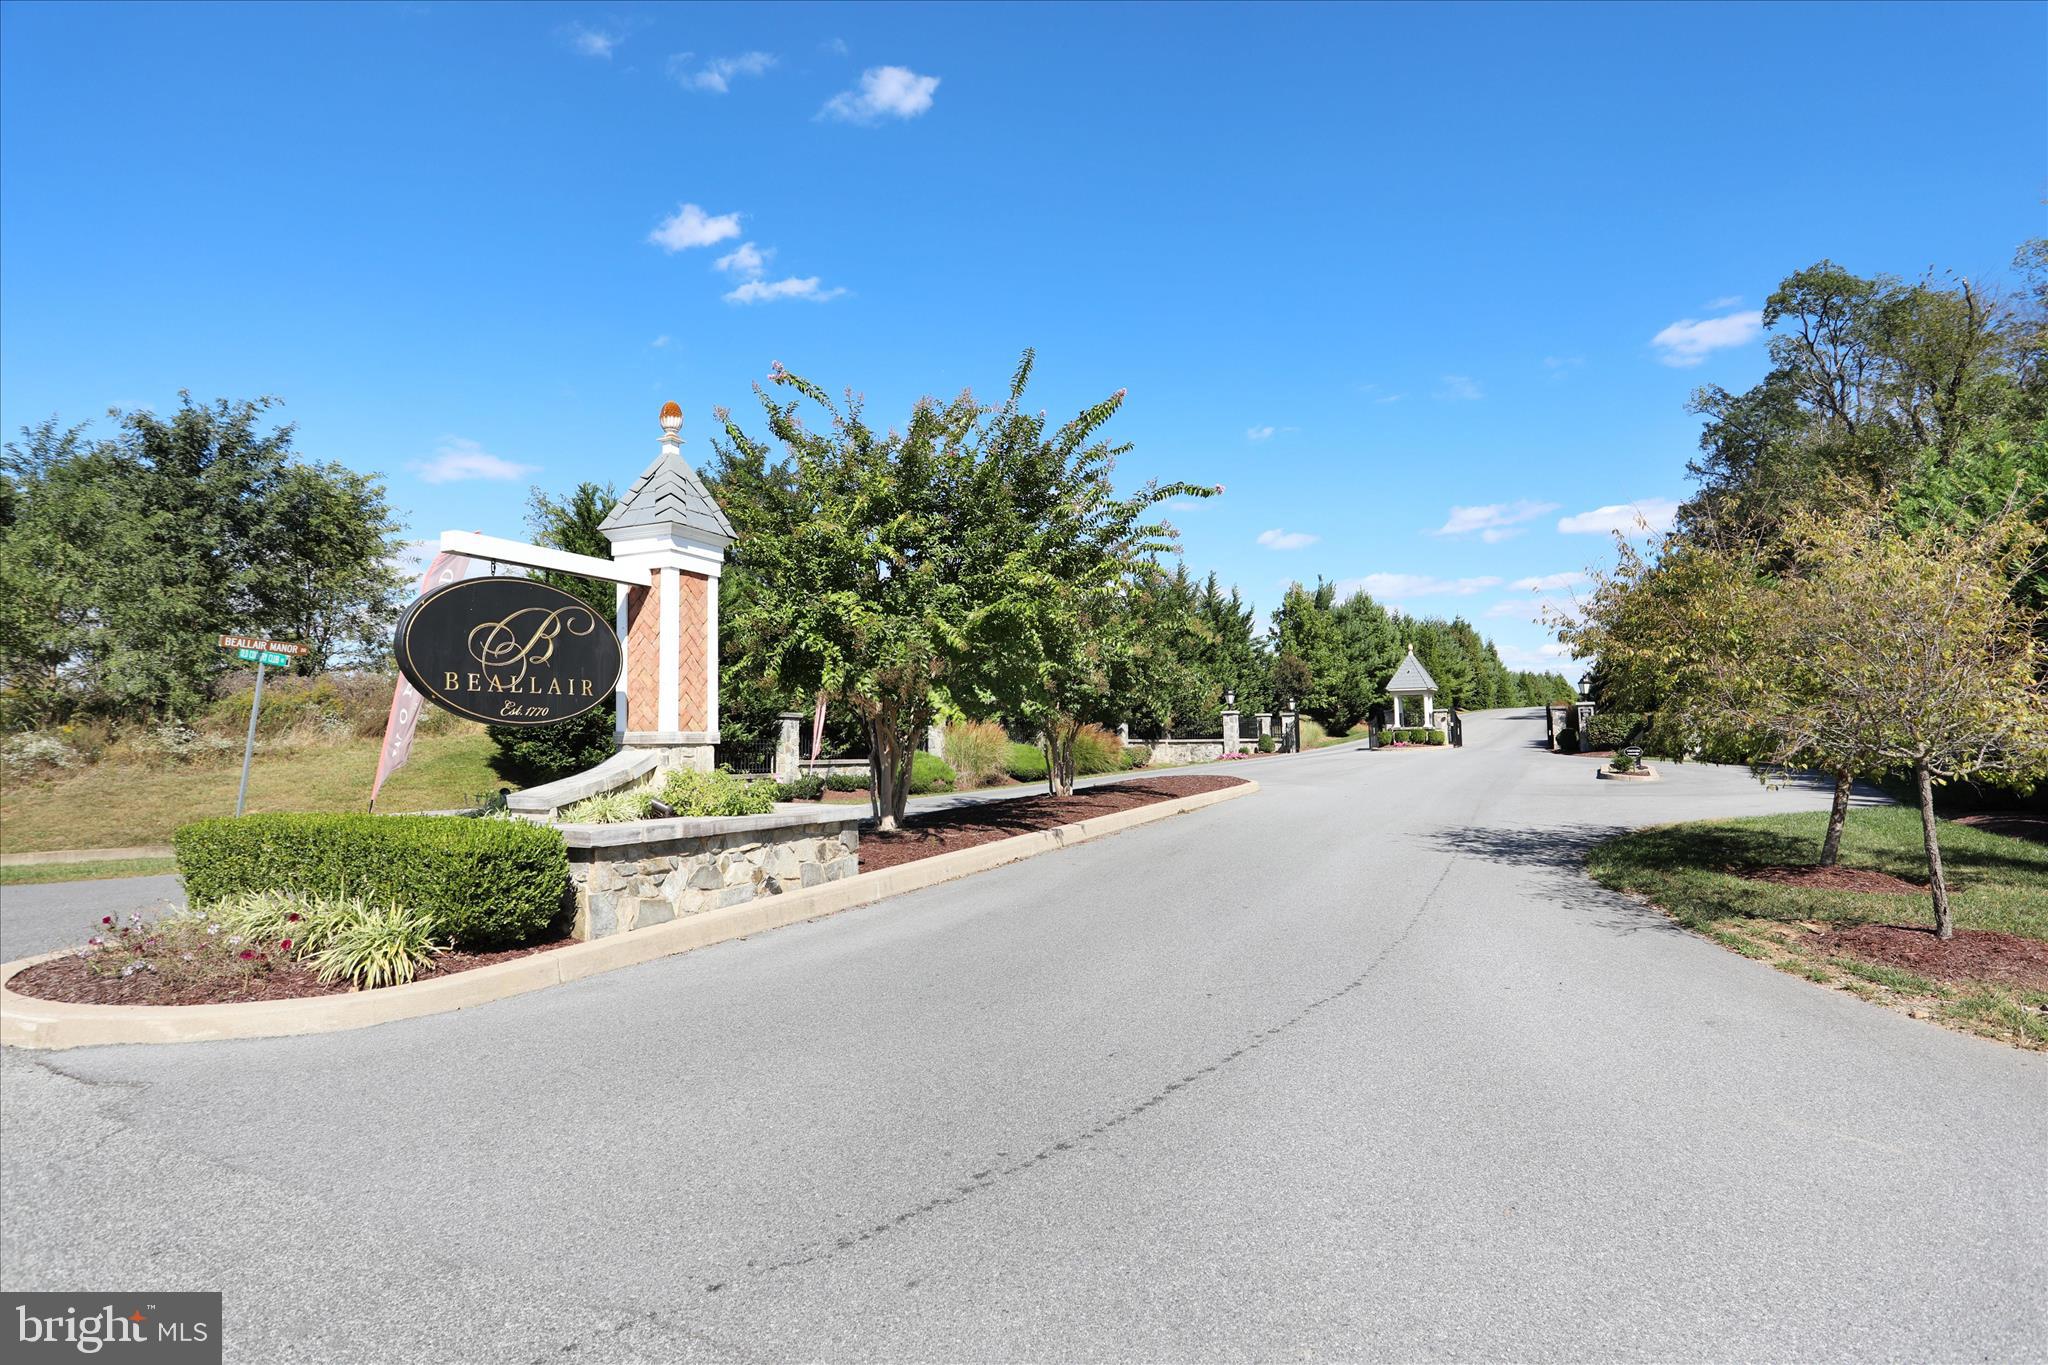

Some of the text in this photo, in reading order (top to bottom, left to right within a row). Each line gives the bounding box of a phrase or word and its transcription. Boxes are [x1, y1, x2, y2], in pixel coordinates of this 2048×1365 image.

[225, 637, 267, 650] BEALLAIR
[270, 643, 298, 654] MANOR
[444, 671, 593, 697] BEALLAIR
[500, 700, 549, 717] Est. 1770
